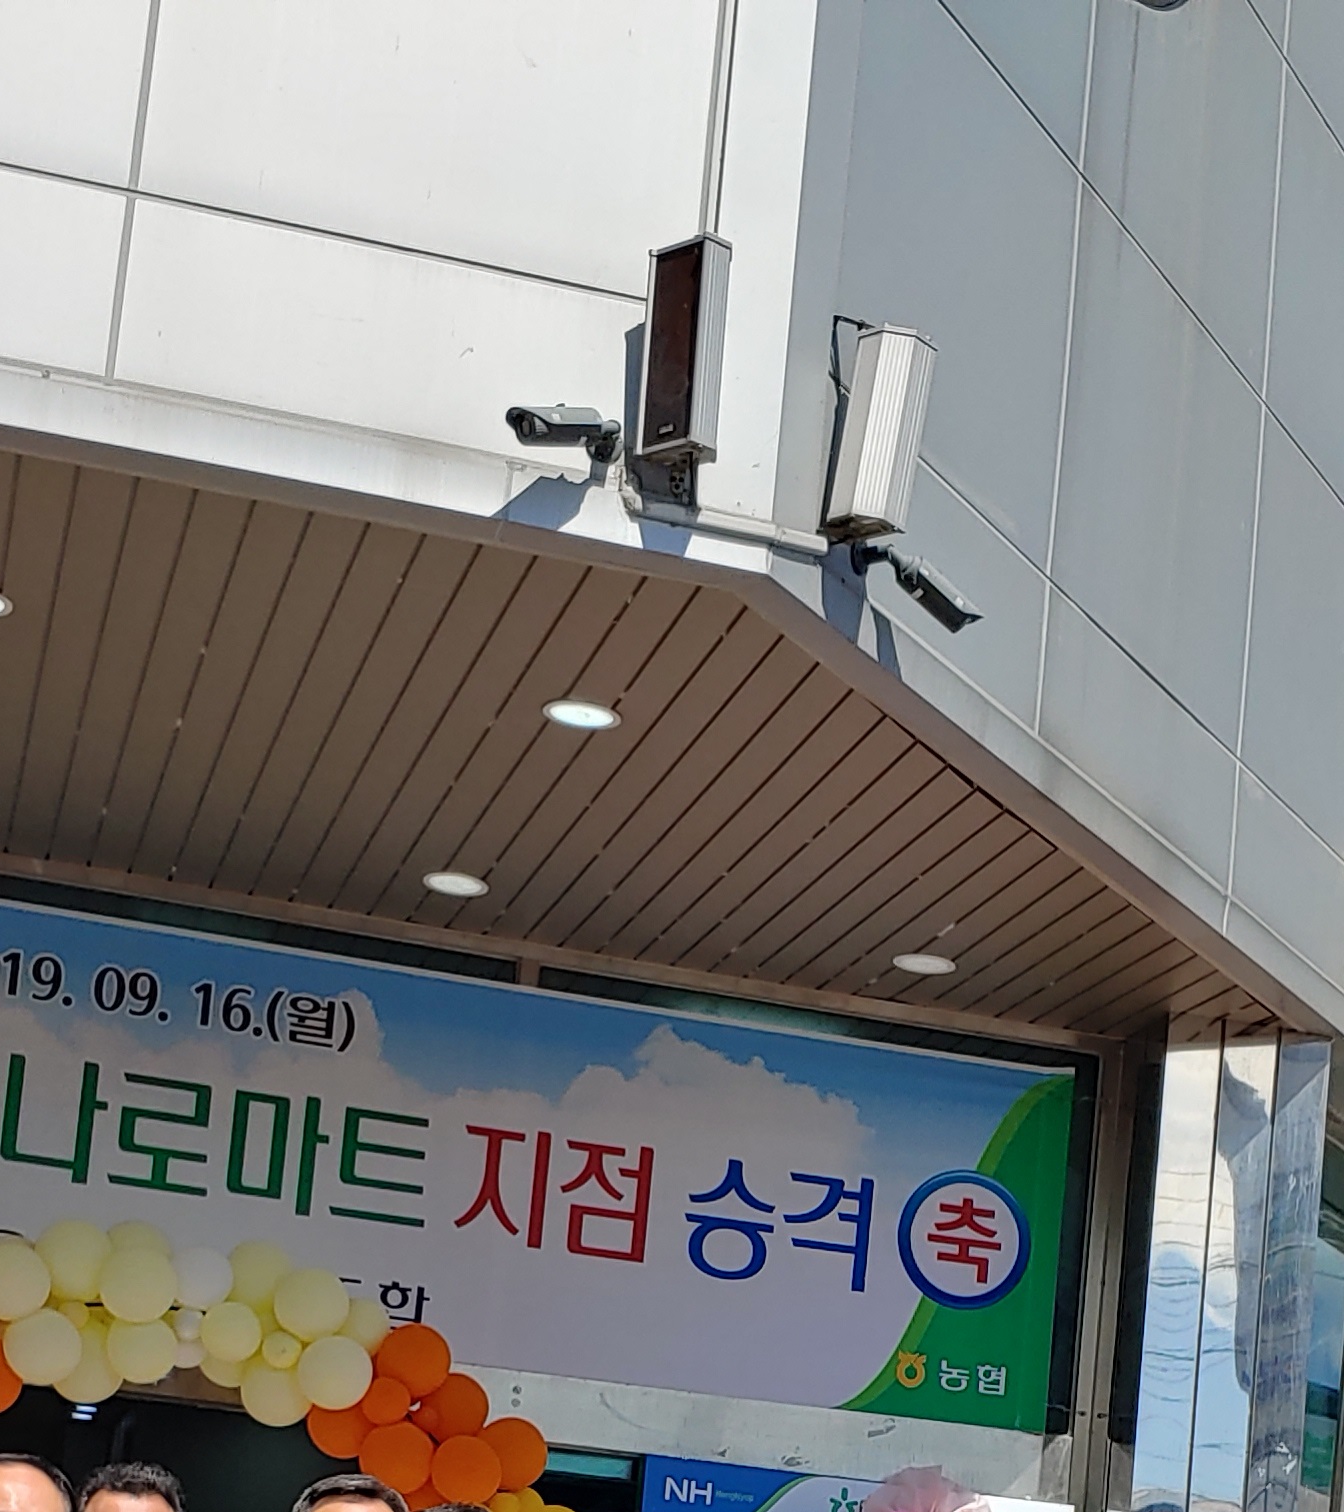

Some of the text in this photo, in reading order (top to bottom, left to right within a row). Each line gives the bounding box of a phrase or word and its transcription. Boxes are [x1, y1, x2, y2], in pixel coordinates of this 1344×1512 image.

[93, 964, 171, 1025] 09.
[454, 1121, 656, 1264] 지점
[683, 1158, 876, 1292] 승격
[926, 1198, 1004, 1285] 축
[937, 1358, 1008, 1396] 농협
[663, 1475, 714, 1507] NH
